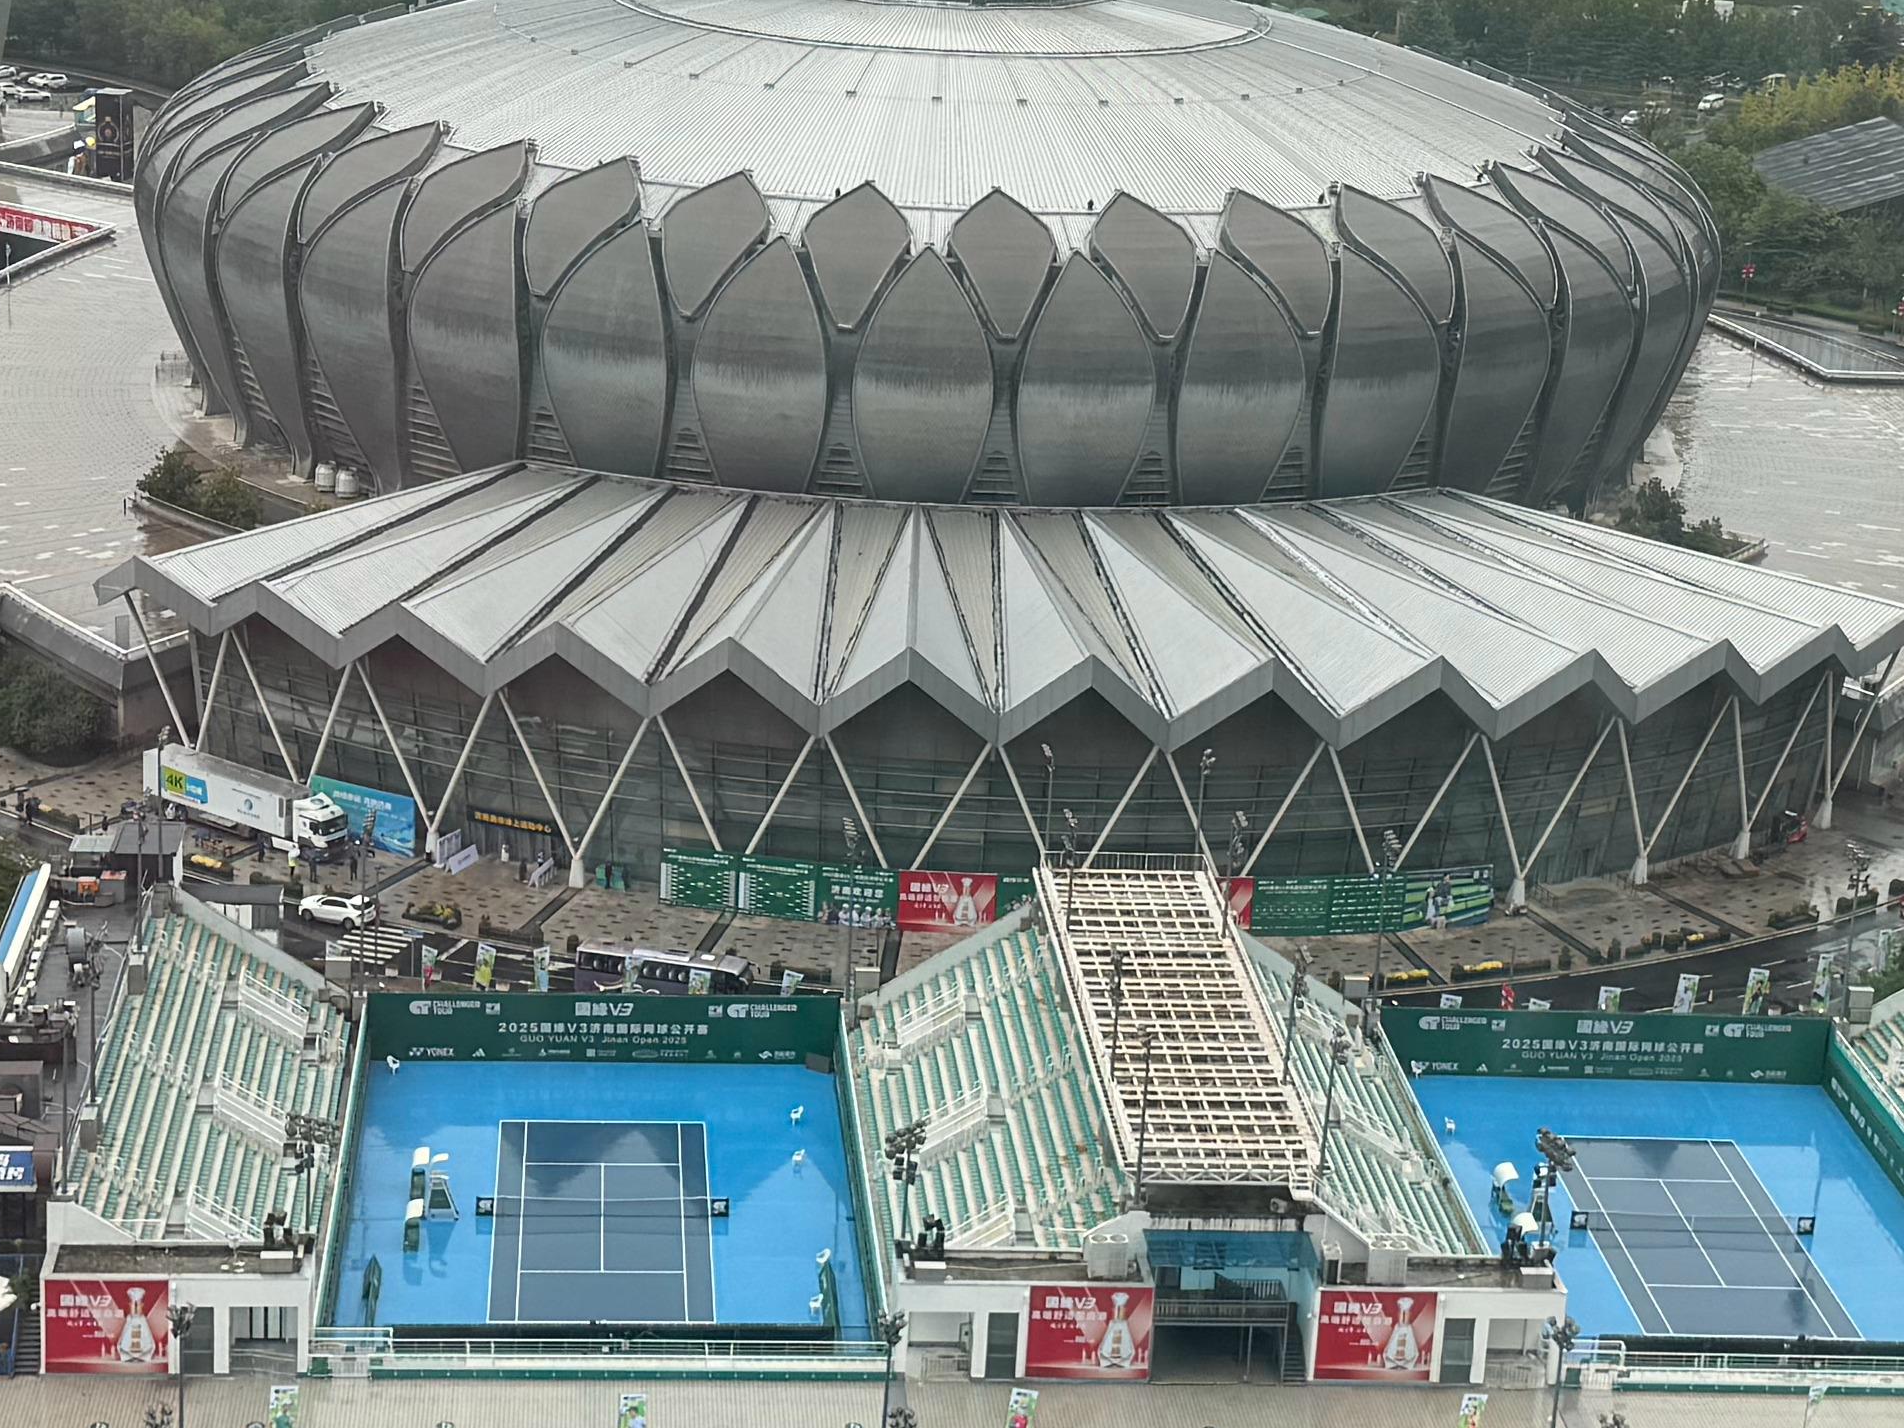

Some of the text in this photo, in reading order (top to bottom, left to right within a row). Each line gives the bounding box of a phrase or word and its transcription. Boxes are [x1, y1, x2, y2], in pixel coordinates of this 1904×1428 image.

[165, 773, 184, 790] 4K
[520, 1035, 687, 1045] GUO YUAN V3 Jinan Open 2025
[426, 1047, 454, 1057] YONEX
[1521, 1051, 1545, 1060] GUO
[1548, 1051, 1576, 1060] YUAN
[1580, 1052, 1594, 1061] V3
[1629, 1054, 1655, 1064] Open
[1432, 1061, 1459, 1071] YONEX
